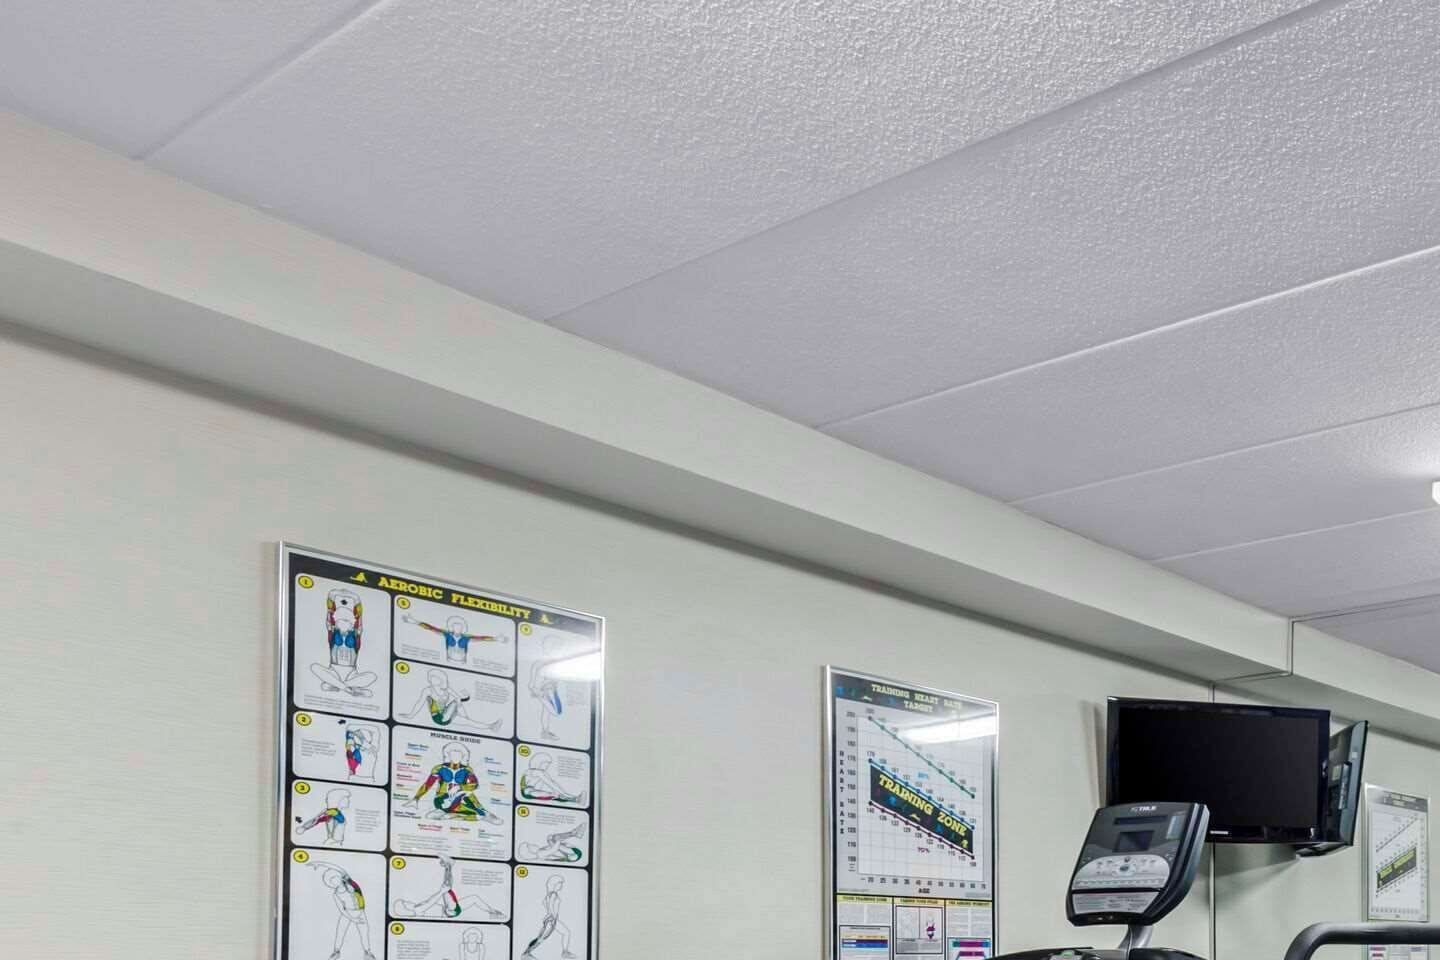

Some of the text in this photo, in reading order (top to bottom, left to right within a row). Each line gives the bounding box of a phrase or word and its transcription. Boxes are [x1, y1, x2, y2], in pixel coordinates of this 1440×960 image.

[378, 576, 532, 619] AEROBIC FLEXIBILITY
[872, 683, 910, 699] TRAINING
[914, 693, 938, 705] HEART
[903, 700, 934, 713] TARGET
[879, 773, 933, 815] TRAINING
[937, 811, 967, 836] ZONE
